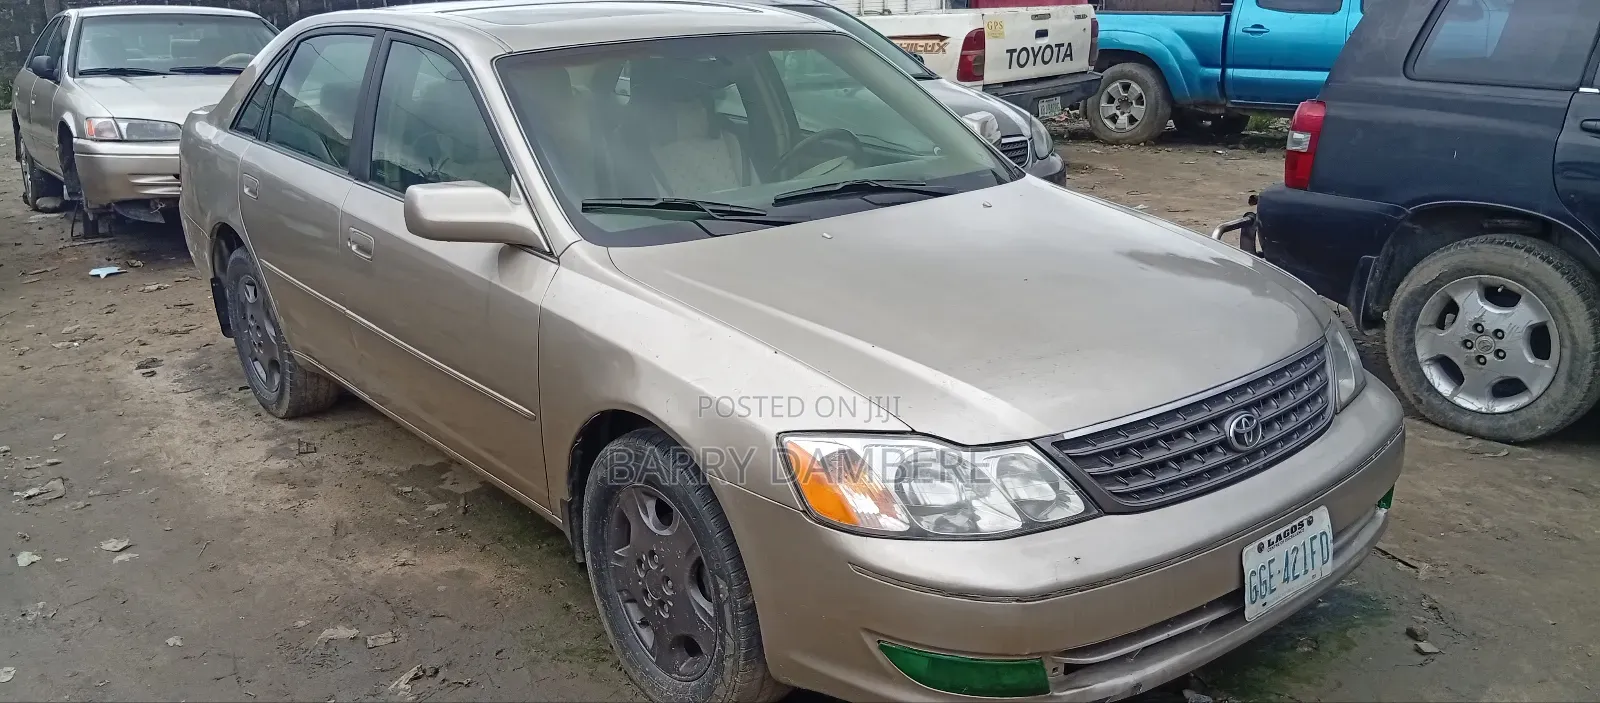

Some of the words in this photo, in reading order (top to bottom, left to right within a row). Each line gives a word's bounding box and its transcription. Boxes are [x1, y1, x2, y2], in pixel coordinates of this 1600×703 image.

[987, 20, 1004, 31] GPS
[1005, 42, 1073, 69] TOYOTA
[1267, 520, 1305, 547] LAGOS
